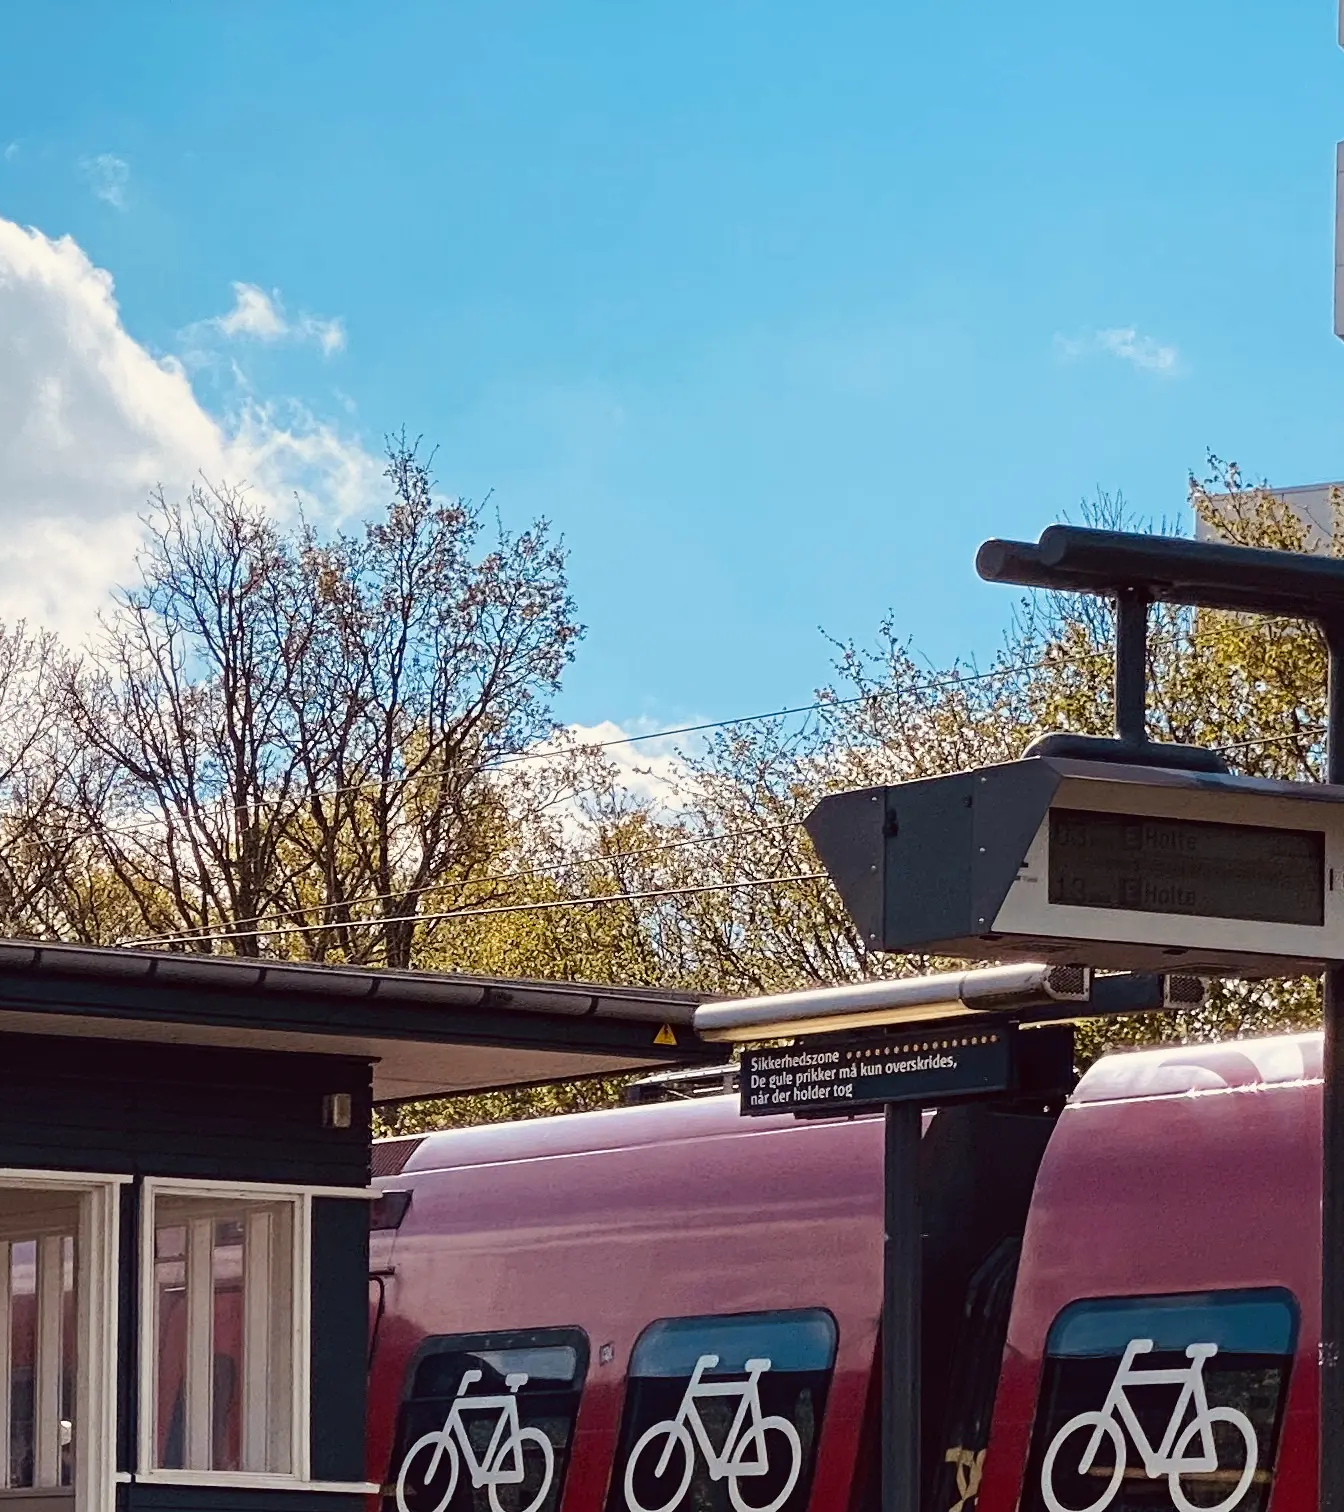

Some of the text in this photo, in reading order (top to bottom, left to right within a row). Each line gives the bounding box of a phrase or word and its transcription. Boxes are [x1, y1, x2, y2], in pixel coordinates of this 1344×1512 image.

[1145, 827, 1198, 851] Holte
[1144, 882, 1196, 907] Holte
[750, 1051, 840, 1072] Sikkerhedszone
[750, 1053, 958, 1089] De gule prikker må kun overskrides,
[750, 1083, 853, 1105] når der holder tog
